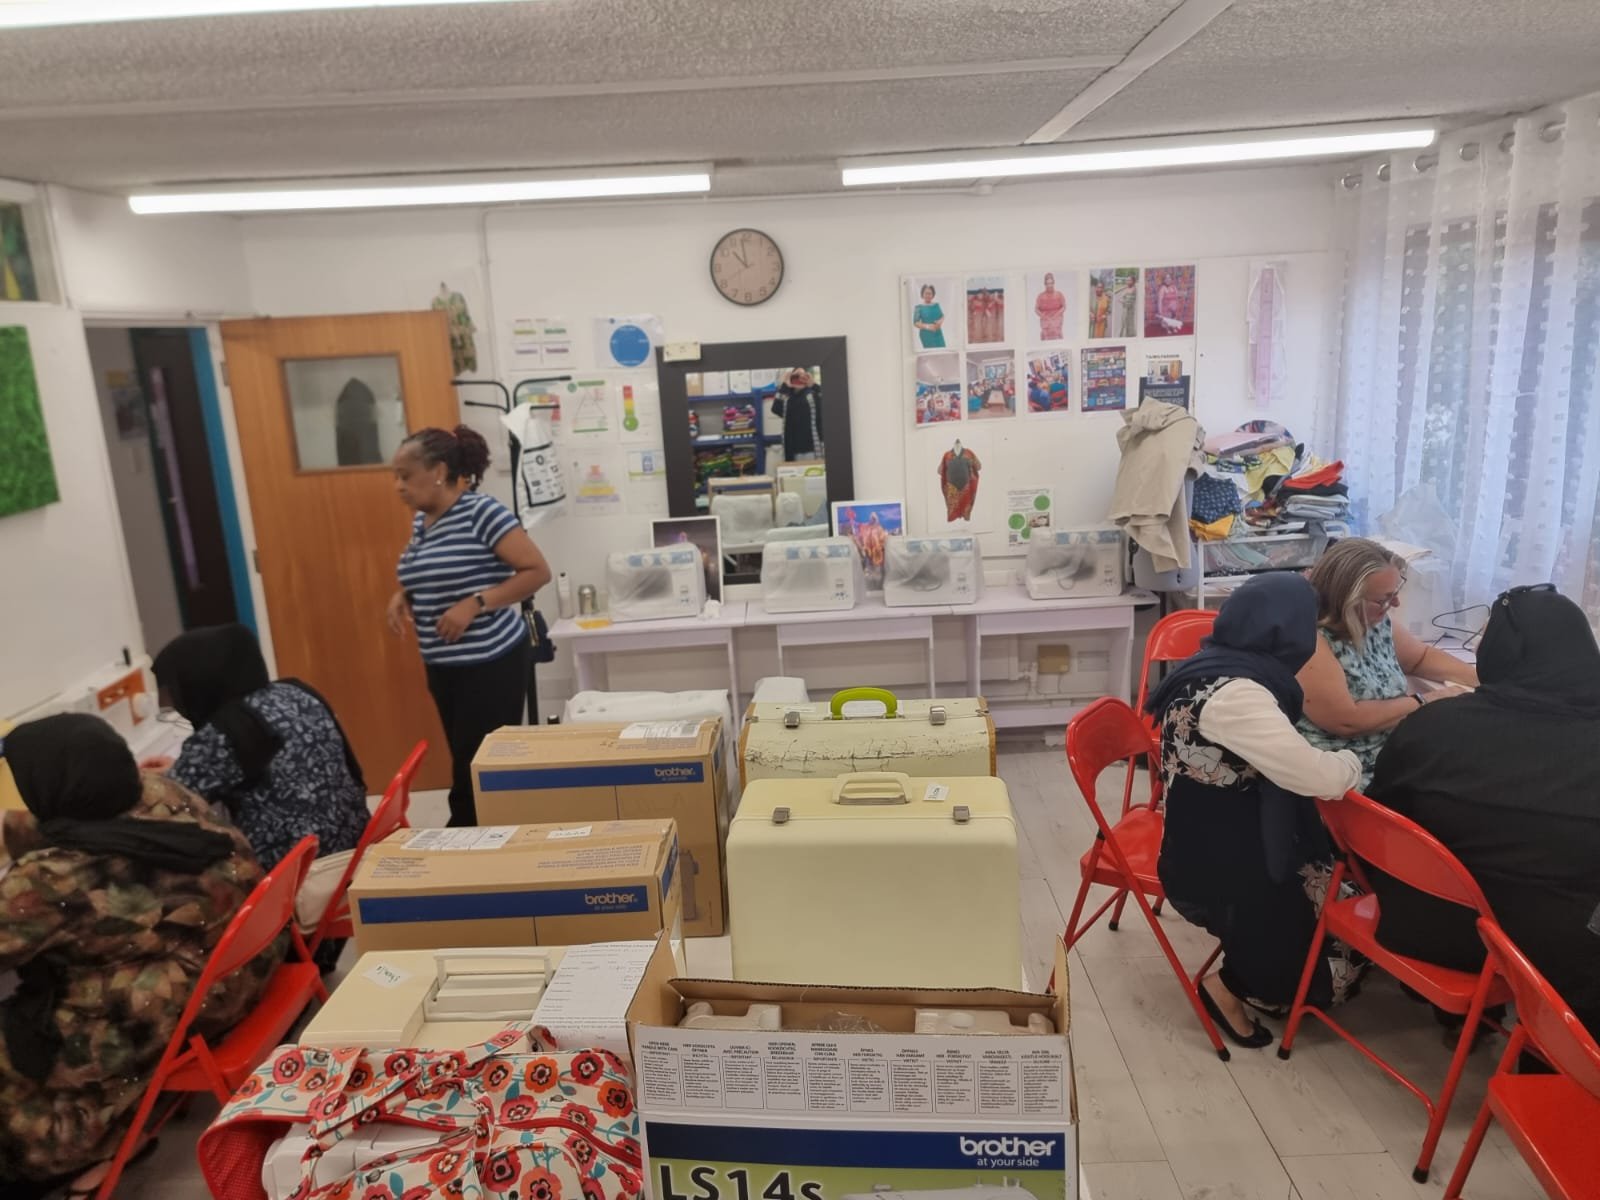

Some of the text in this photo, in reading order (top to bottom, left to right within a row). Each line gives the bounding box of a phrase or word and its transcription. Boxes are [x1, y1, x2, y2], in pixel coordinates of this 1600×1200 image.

[654, 767, 694, 777] brother
[584, 892, 635, 906] brother
[959, 1135, 1057, 1156] brother
[976, 1156, 1040, 1169] at your side
[660, 1164, 824, 1200] LS14s
